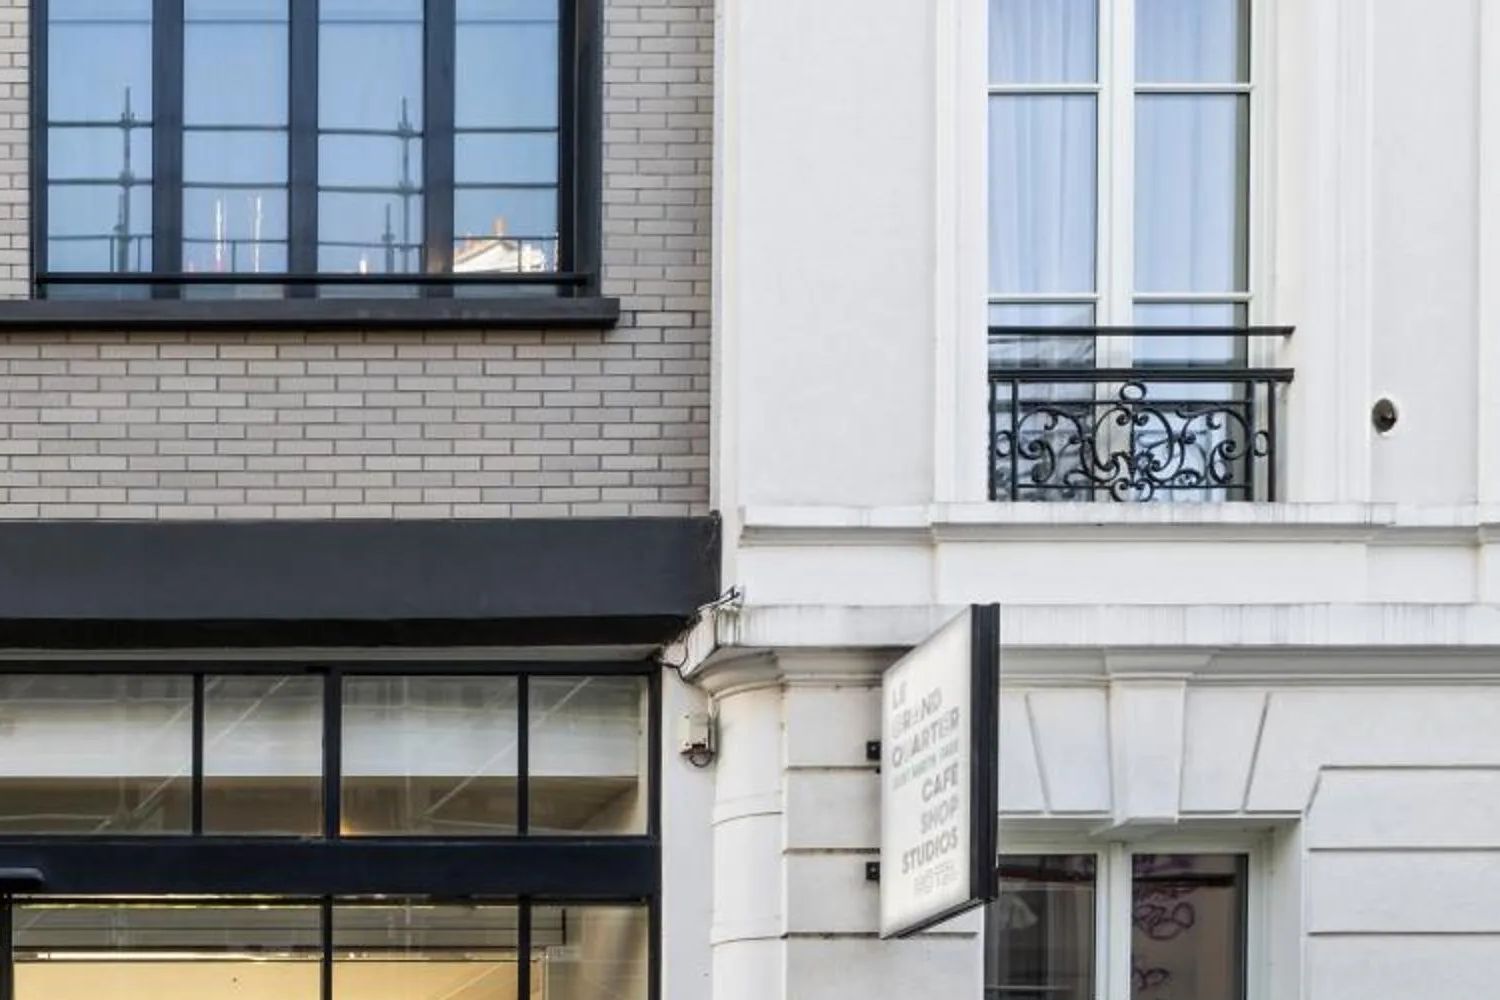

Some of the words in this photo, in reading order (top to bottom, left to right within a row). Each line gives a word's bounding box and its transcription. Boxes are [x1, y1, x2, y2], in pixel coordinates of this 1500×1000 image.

[892, 706, 960, 769] QARTIER
[921, 792, 959, 834] SHOP
[901, 825, 958, 874] STUDIOS
